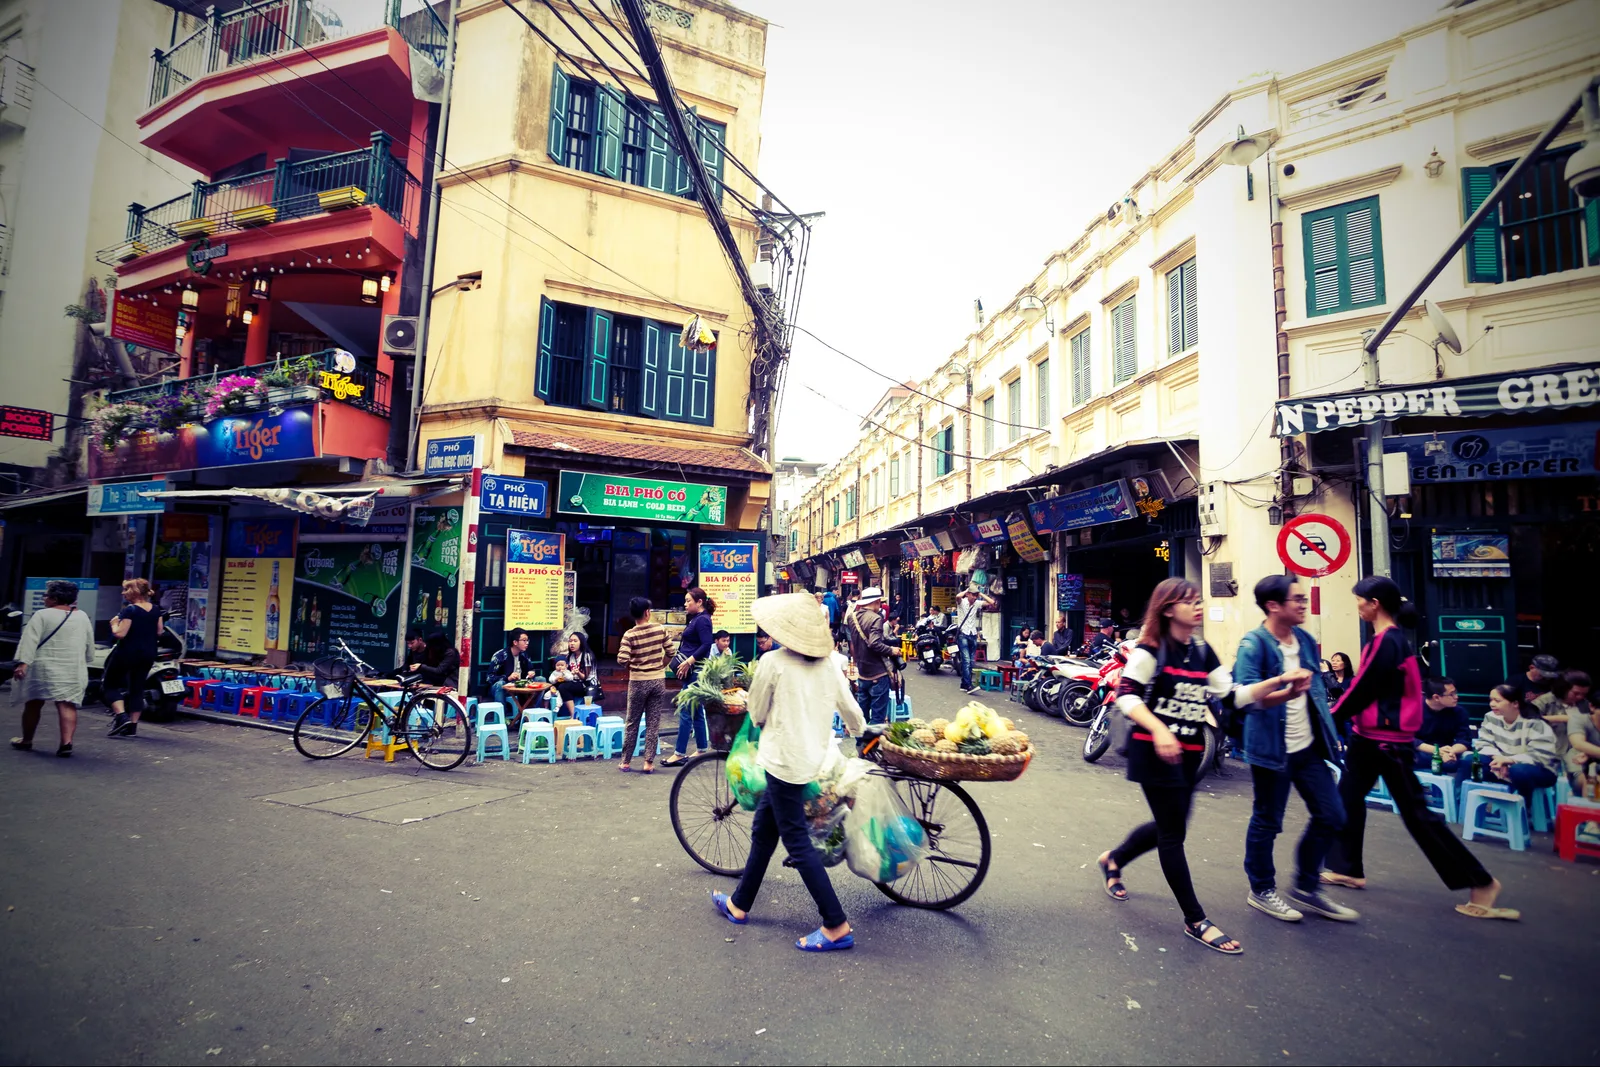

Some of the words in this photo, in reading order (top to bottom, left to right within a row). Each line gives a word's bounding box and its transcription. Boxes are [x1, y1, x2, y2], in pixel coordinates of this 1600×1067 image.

[319, 370, 365, 400] Tiger
[1497, 368, 1600, 410] GRE
[1312, 387, 1462, 429] PEPPER
[5, 412, 41, 425] BOOK
[233, 419, 281, 460] Tiger
[443, 441, 460, 452] PHỐ
[1468, 457, 1580, 478] PEPPER
[504, 483, 526, 493] PHỐ
[604, 484, 630, 496] BIA
[633, 485, 665, 500] PHỐ
[489, 493, 505, 509] TẠ
[508, 494, 539, 512] HIỆN
[603, 498, 617, 506] BIA
[645, 501, 665, 511] COLD
[666, 503, 686, 512] BEER
[1136, 497, 1165, 518] Tiger
[979, 525, 992, 534] BIA
[991, 523, 1000, 531] 23
[245, 523, 282, 554] Tiger
[442, 536, 459, 548] OPEN
[441, 545, 458, 556] FOR
[520, 538, 558, 561] Tiger
[308, 558, 335, 569] TUBORG
[440, 554, 458, 568] FUN
[711, 549, 750, 569] Tiger
[528, 566, 548, 575] PHỐ
[722, 574, 738, 583] PHỐ
